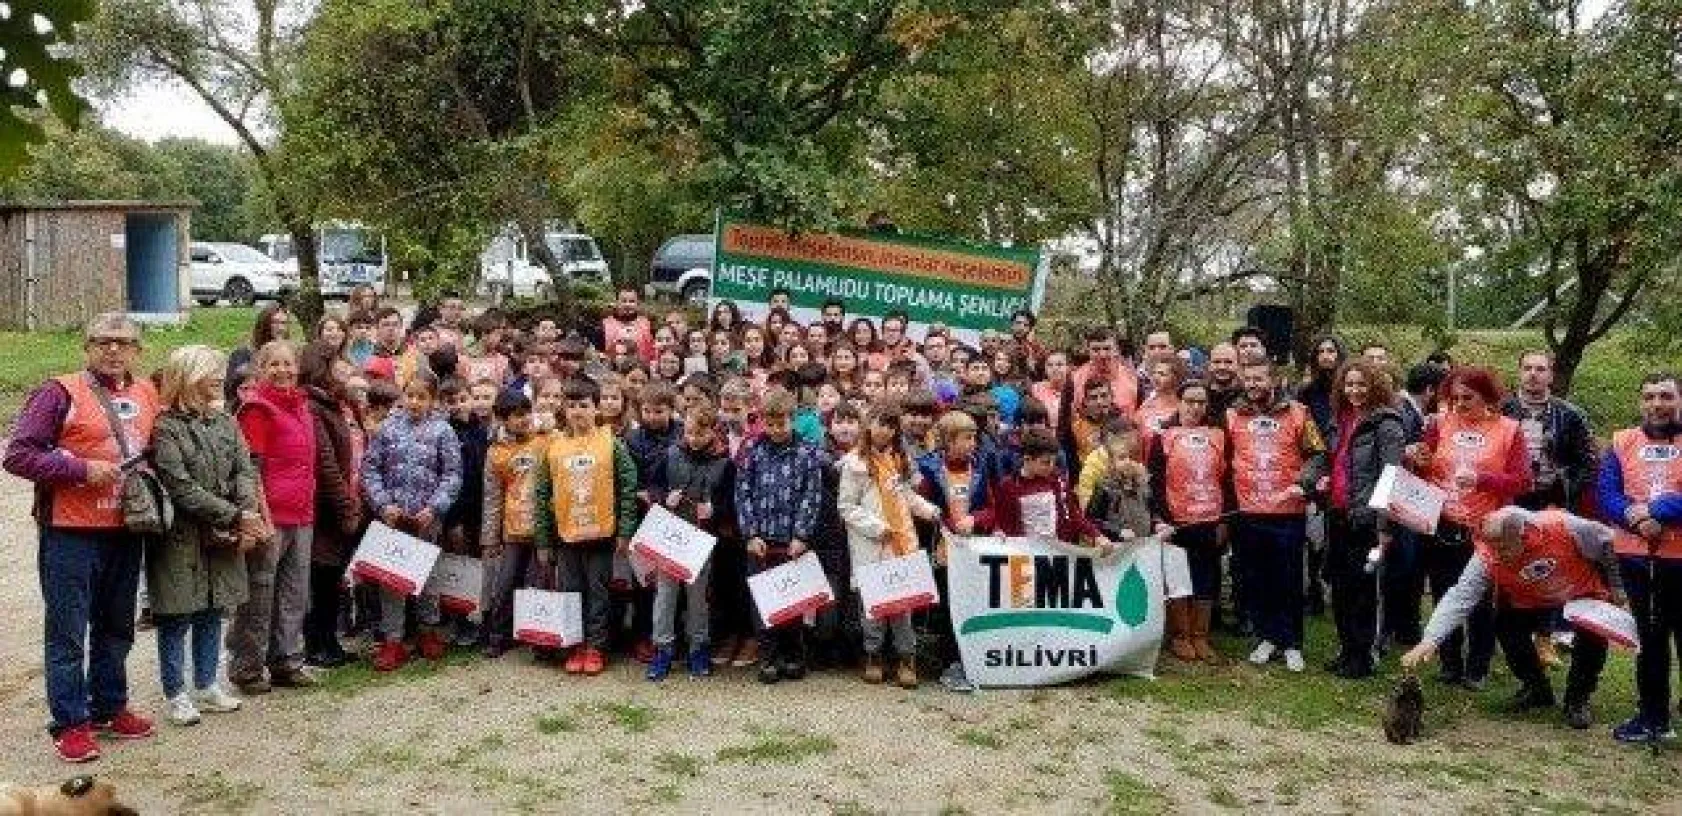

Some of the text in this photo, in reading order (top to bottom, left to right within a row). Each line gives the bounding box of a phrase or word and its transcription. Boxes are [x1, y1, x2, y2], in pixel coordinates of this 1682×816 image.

[718, 263, 769, 290] MEŞE
[773, 270, 869, 298] PALAMUDU
[874, 282, 953, 312] TOPLAMA
[979, 555, 1103, 608] TEMA
[984, 645, 1098, 667] SİLİVRİ
